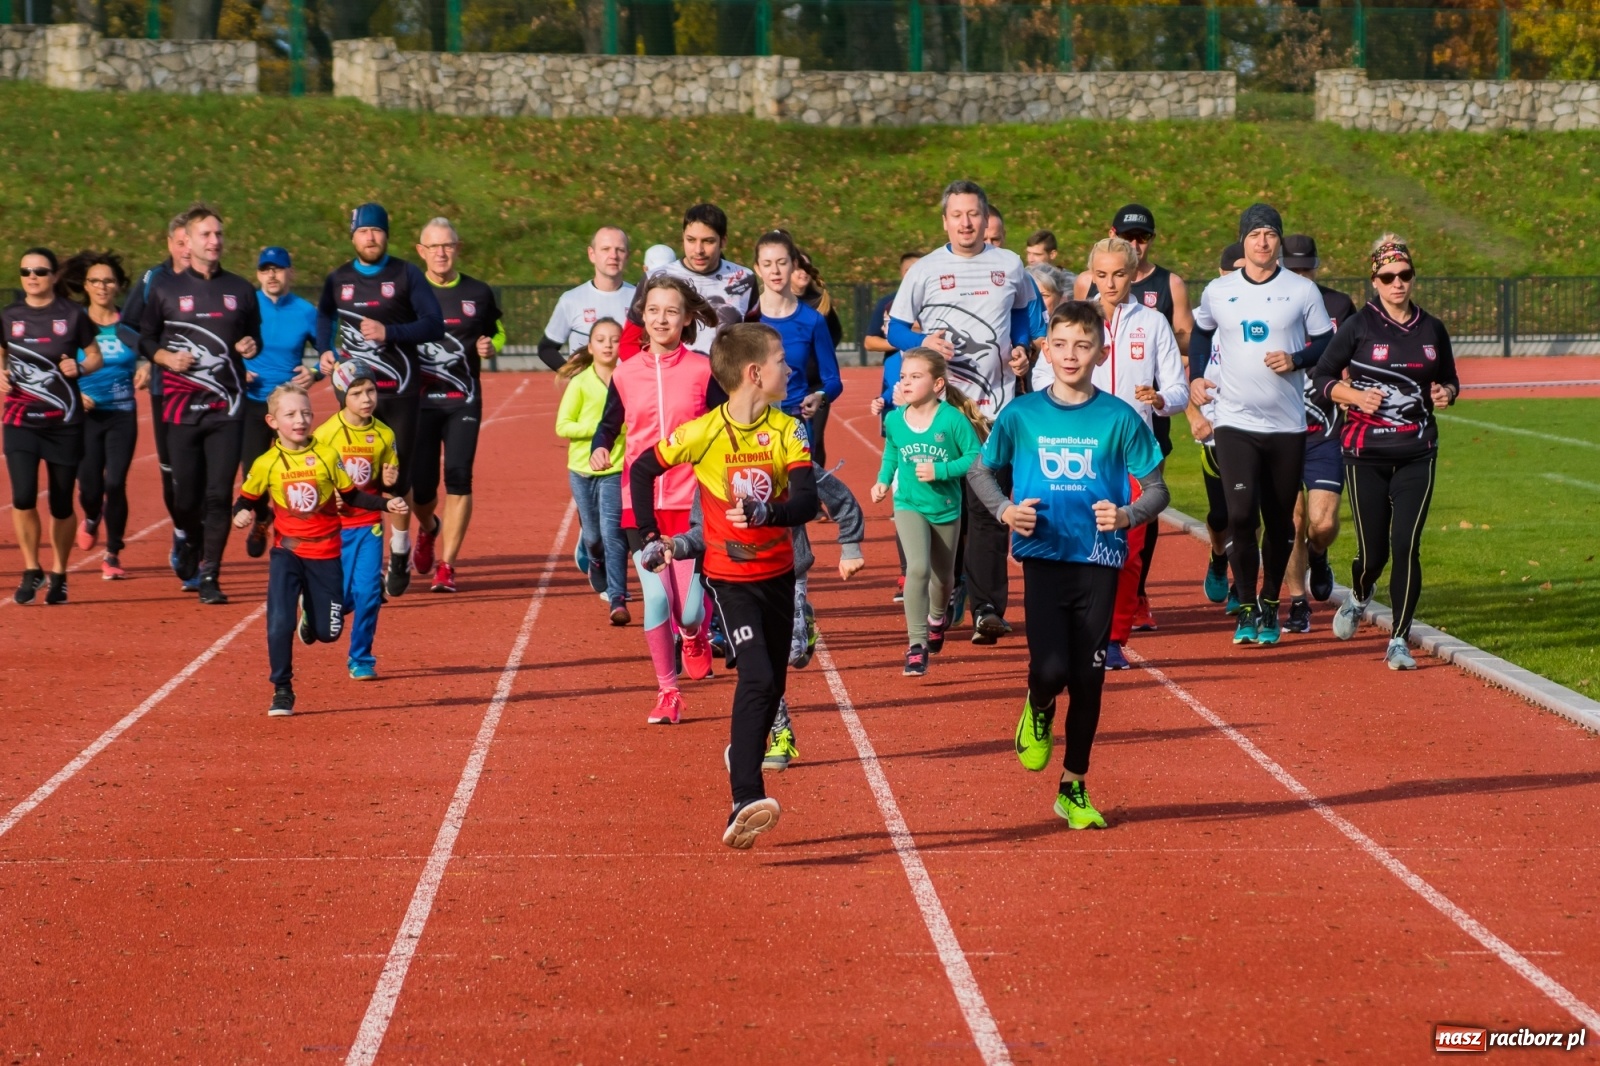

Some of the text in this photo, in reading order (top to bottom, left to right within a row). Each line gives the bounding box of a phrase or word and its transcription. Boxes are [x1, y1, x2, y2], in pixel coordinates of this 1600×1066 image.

[1038, 436, 1099, 446] BiegamBoLubię
[900, 443, 947, 457] BOSTON
[1038, 447, 1097, 480] bbl
[1050, 483, 1087, 491] RACIBÓRZ
[733, 625, 754, 645] 10
